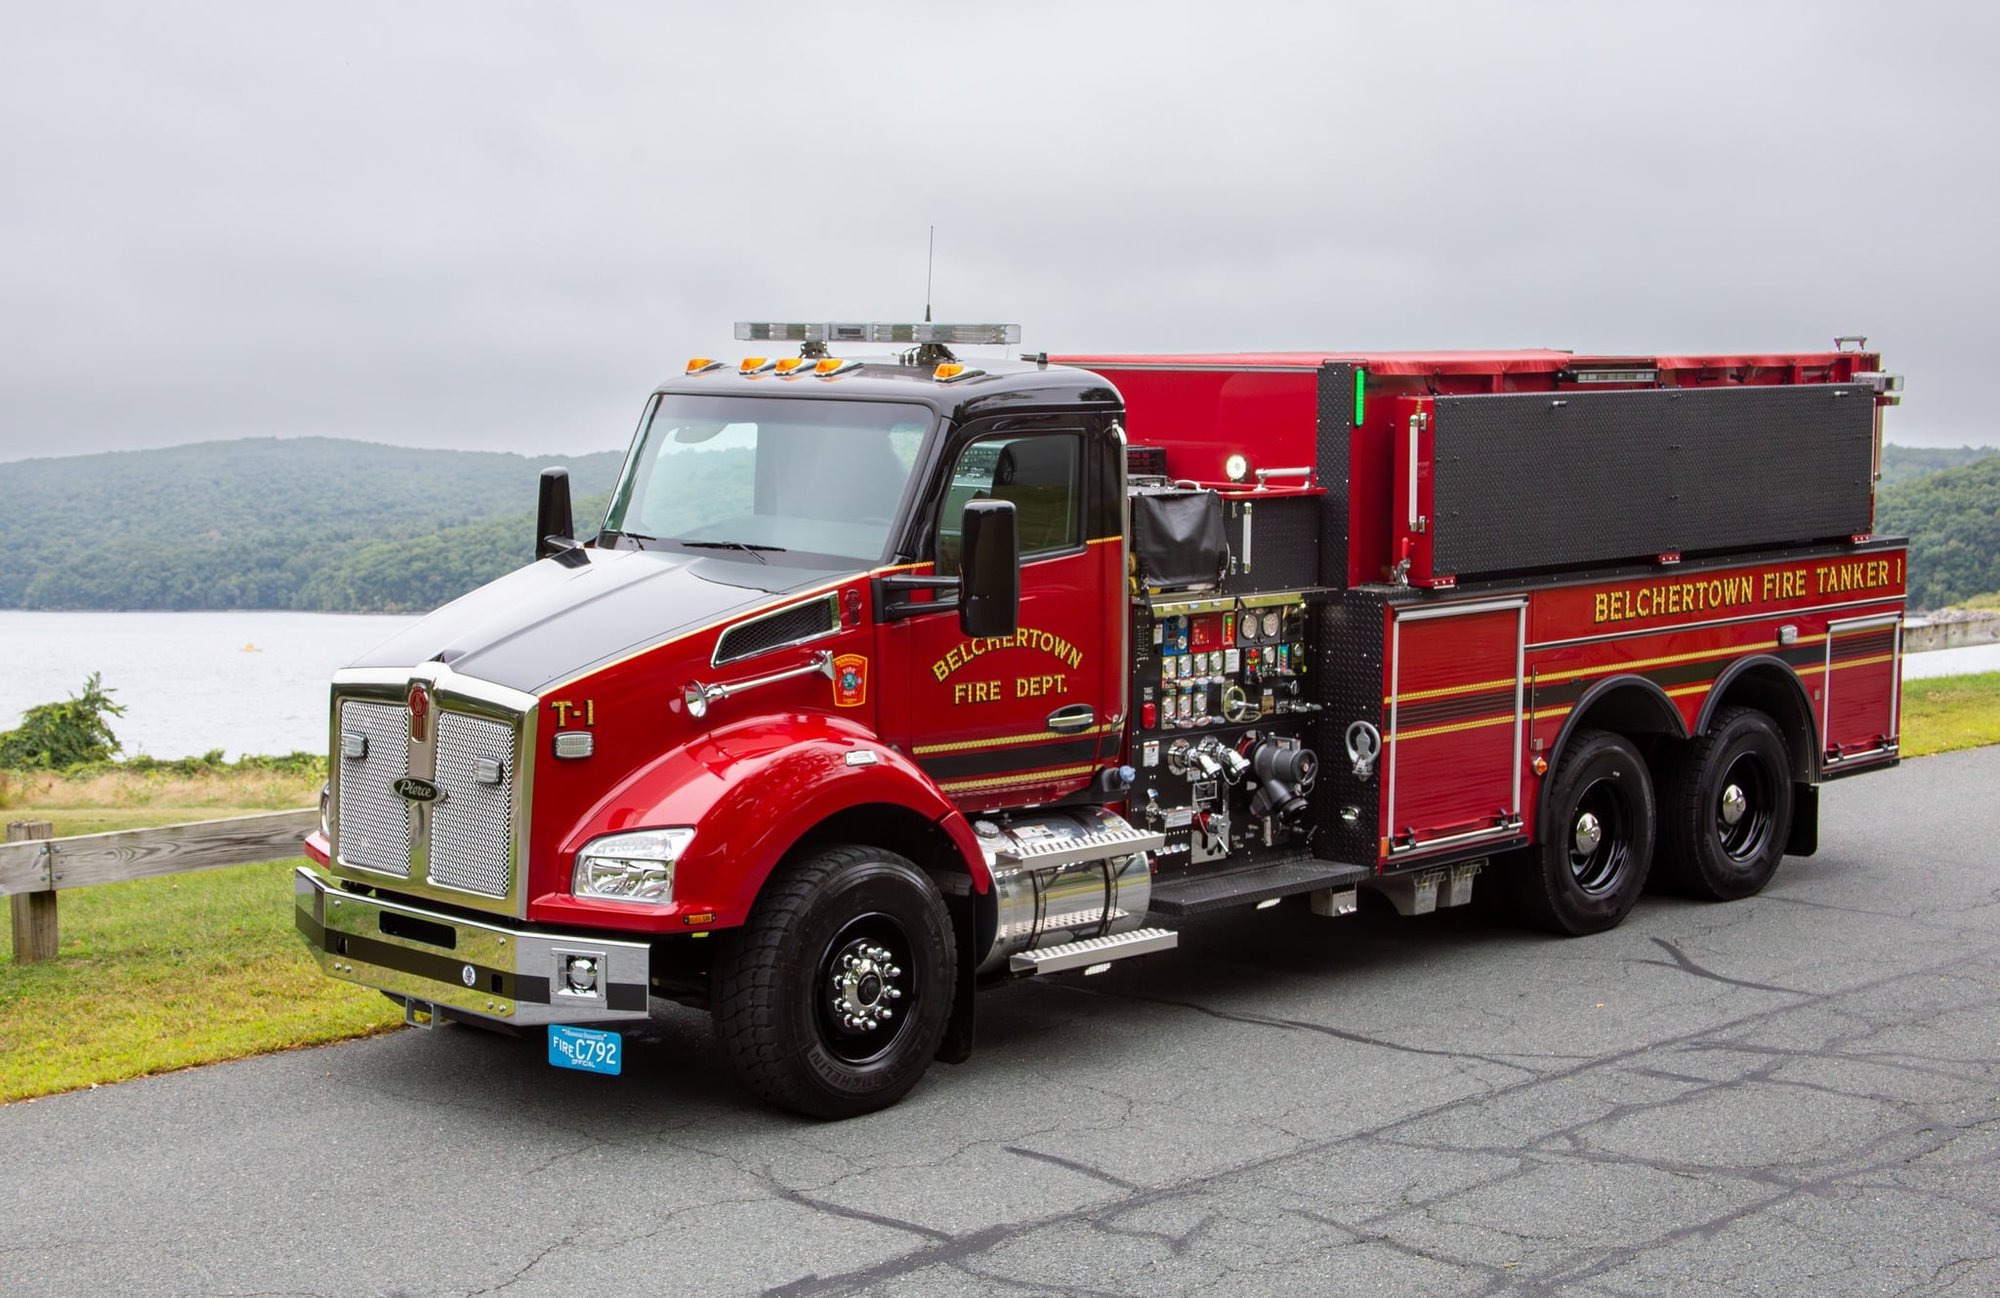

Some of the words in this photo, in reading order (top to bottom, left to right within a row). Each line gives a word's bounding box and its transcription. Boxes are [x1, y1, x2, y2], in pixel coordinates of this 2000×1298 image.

[1594, 575, 1753, 624] BELCHERTOWN
[1763, 569, 1807, 602] FIRE
[1816, 559, 1889, 594] TANKER
[931, 626, 1084, 684] BELCHERTOWN
[954, 680, 1002, 705] FIRE
[1016, 673, 1068, 699] DEPT.
[550, 698, 595, 728] T-1
[399, 779, 432, 798] Pierce
[552, 1035, 575, 1058] FIRE
[575, 1039, 617, 1065] C792
[571, 1058, 596, 1068] OFFICIAL
